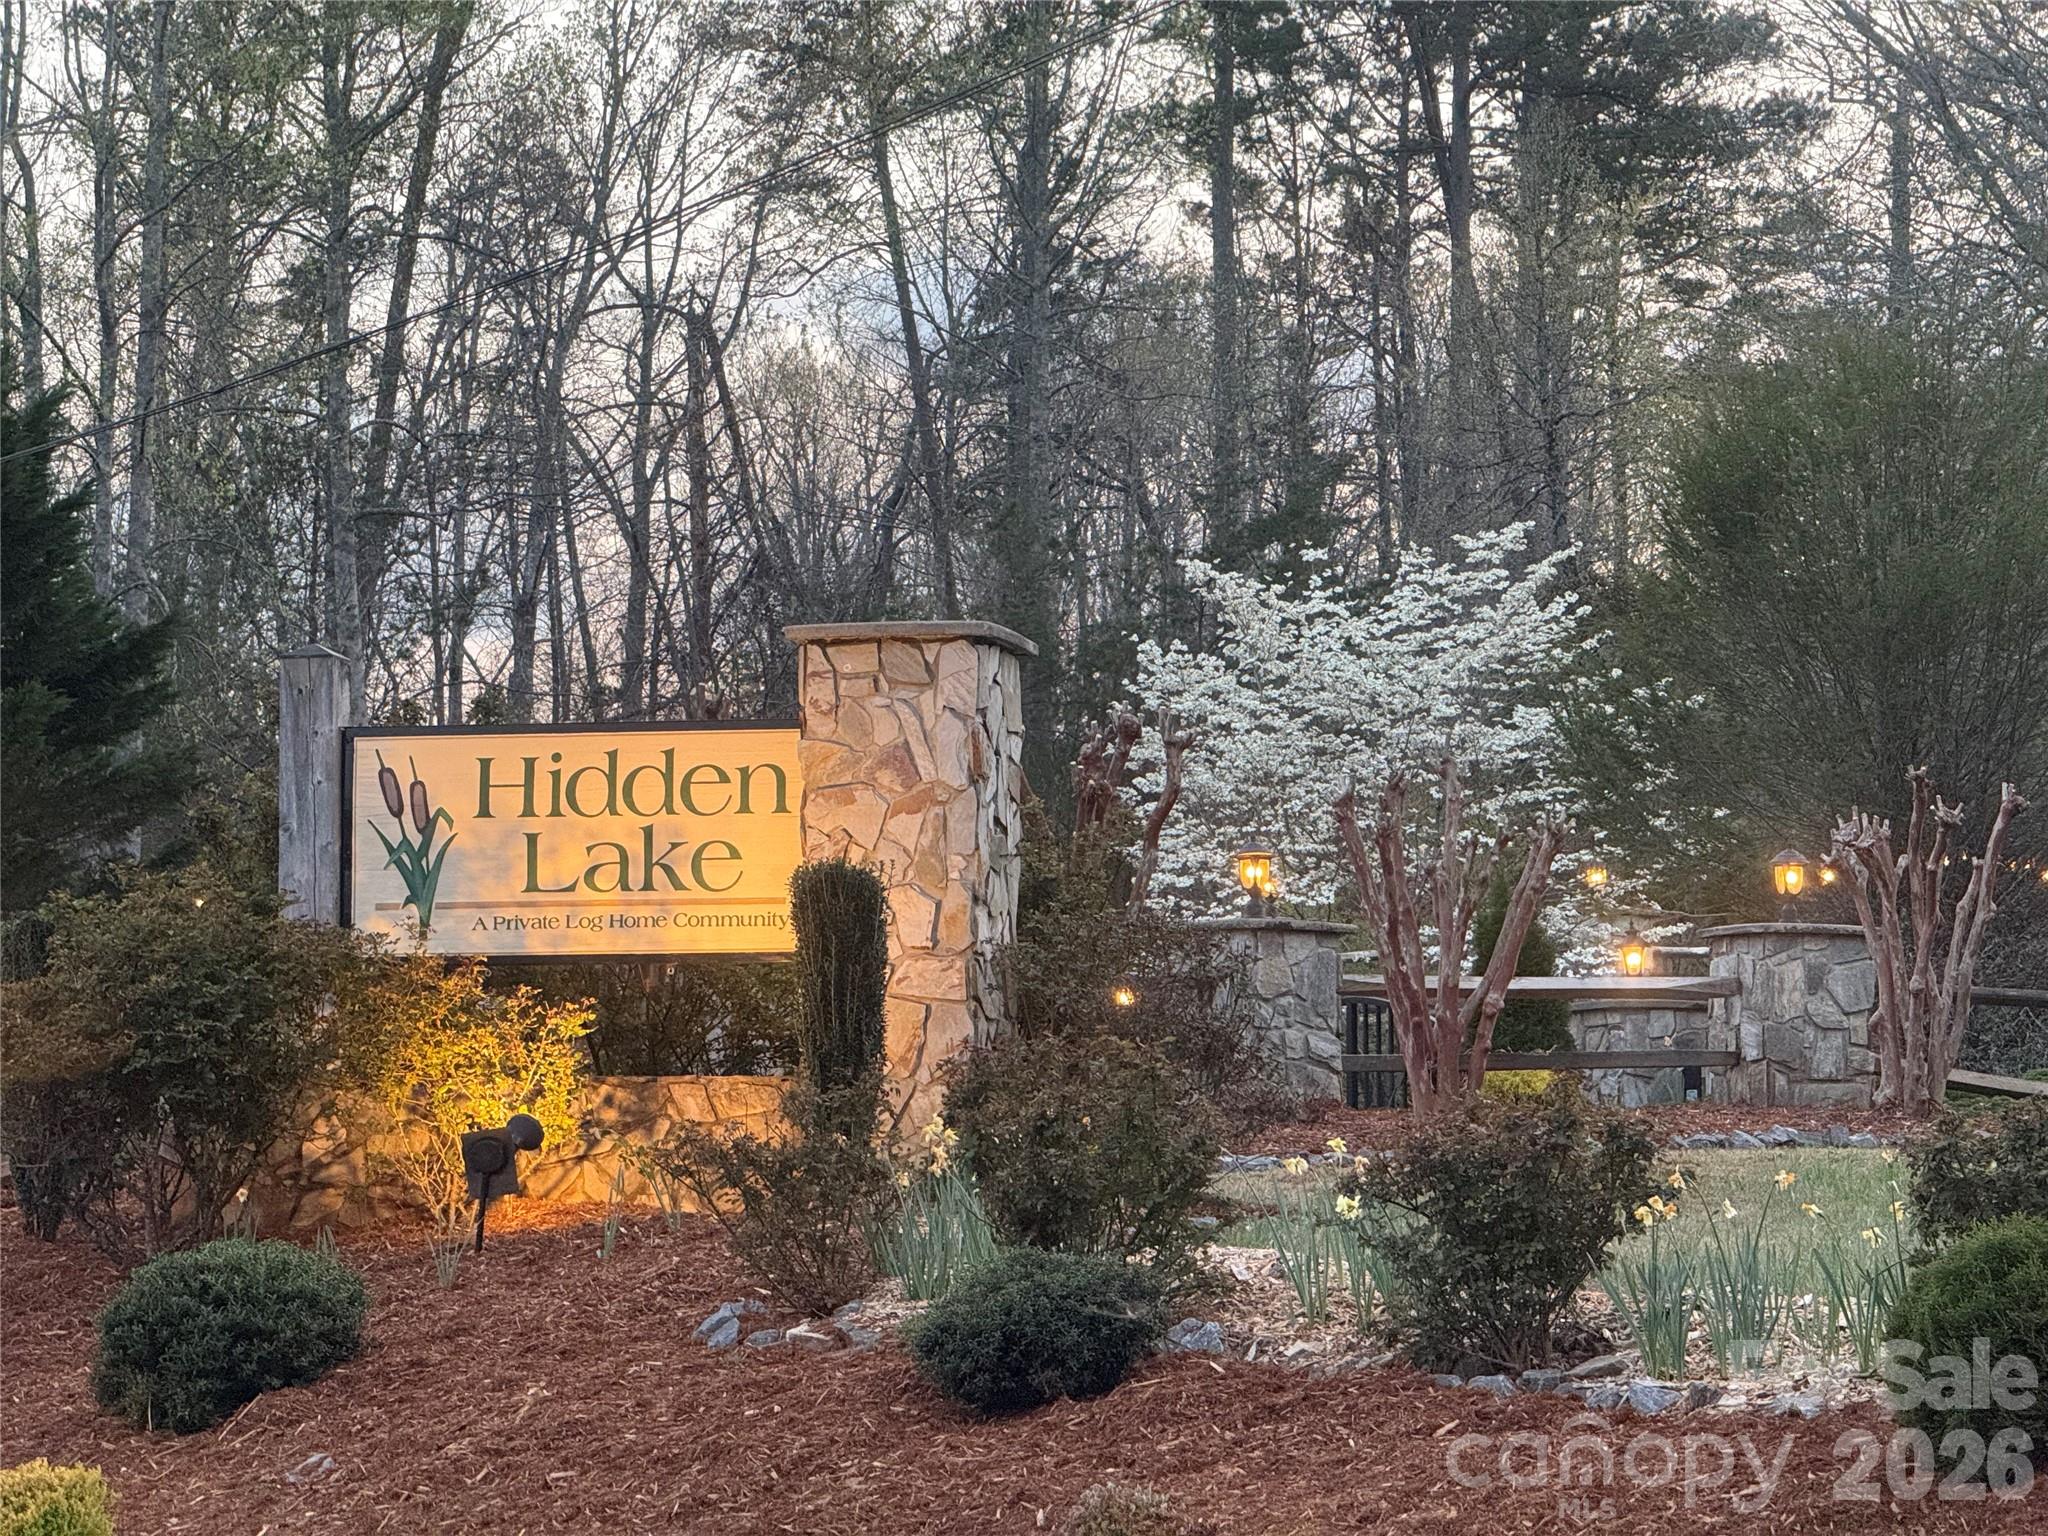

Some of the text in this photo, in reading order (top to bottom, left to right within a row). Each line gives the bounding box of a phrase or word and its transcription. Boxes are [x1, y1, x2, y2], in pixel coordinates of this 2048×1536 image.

[472, 748, 792, 818] Hidden
[521, 824, 743, 893] Lake
[472, 910, 791, 932] A Private Log Home Community
